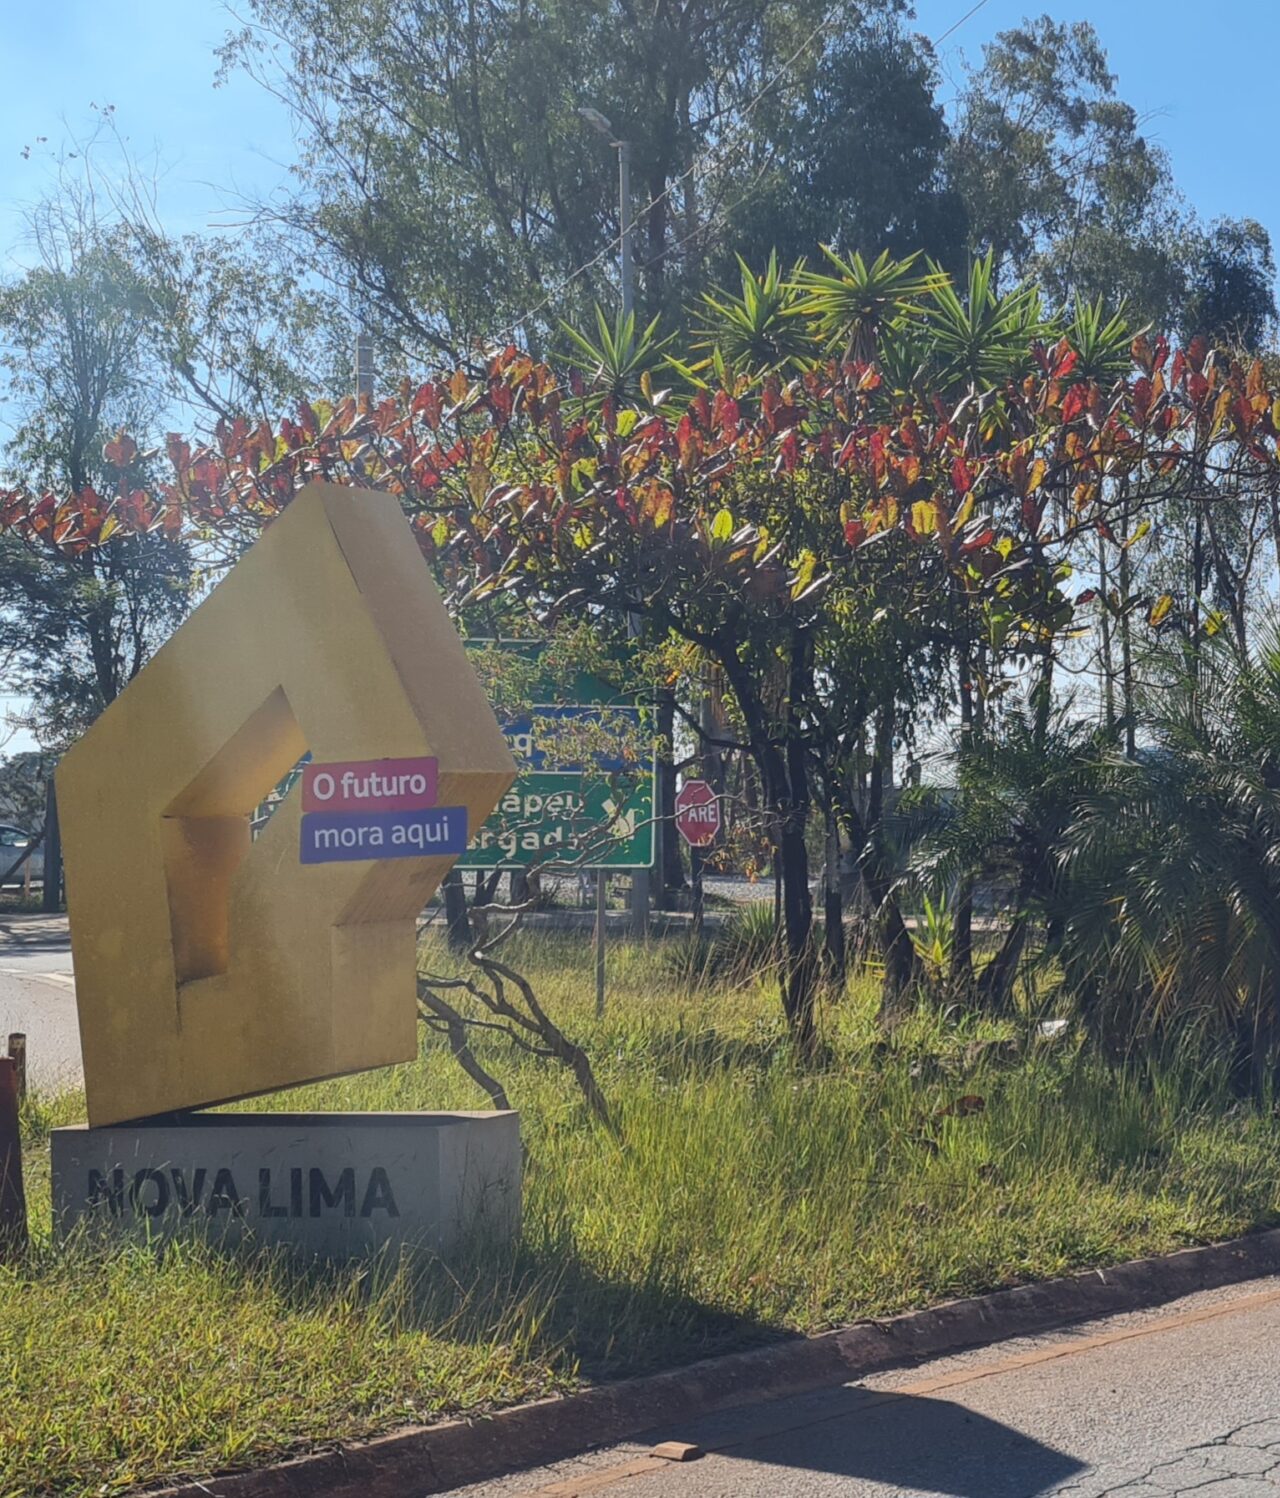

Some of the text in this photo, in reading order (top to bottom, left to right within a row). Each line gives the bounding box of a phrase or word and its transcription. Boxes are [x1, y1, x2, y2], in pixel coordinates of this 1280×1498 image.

[313, 771, 427, 801] O futuro
[678, 803, 717, 823] PARE
[314, 816, 449, 849] mora aqui
[87, 1166, 400, 1219] NOVA LIMA
